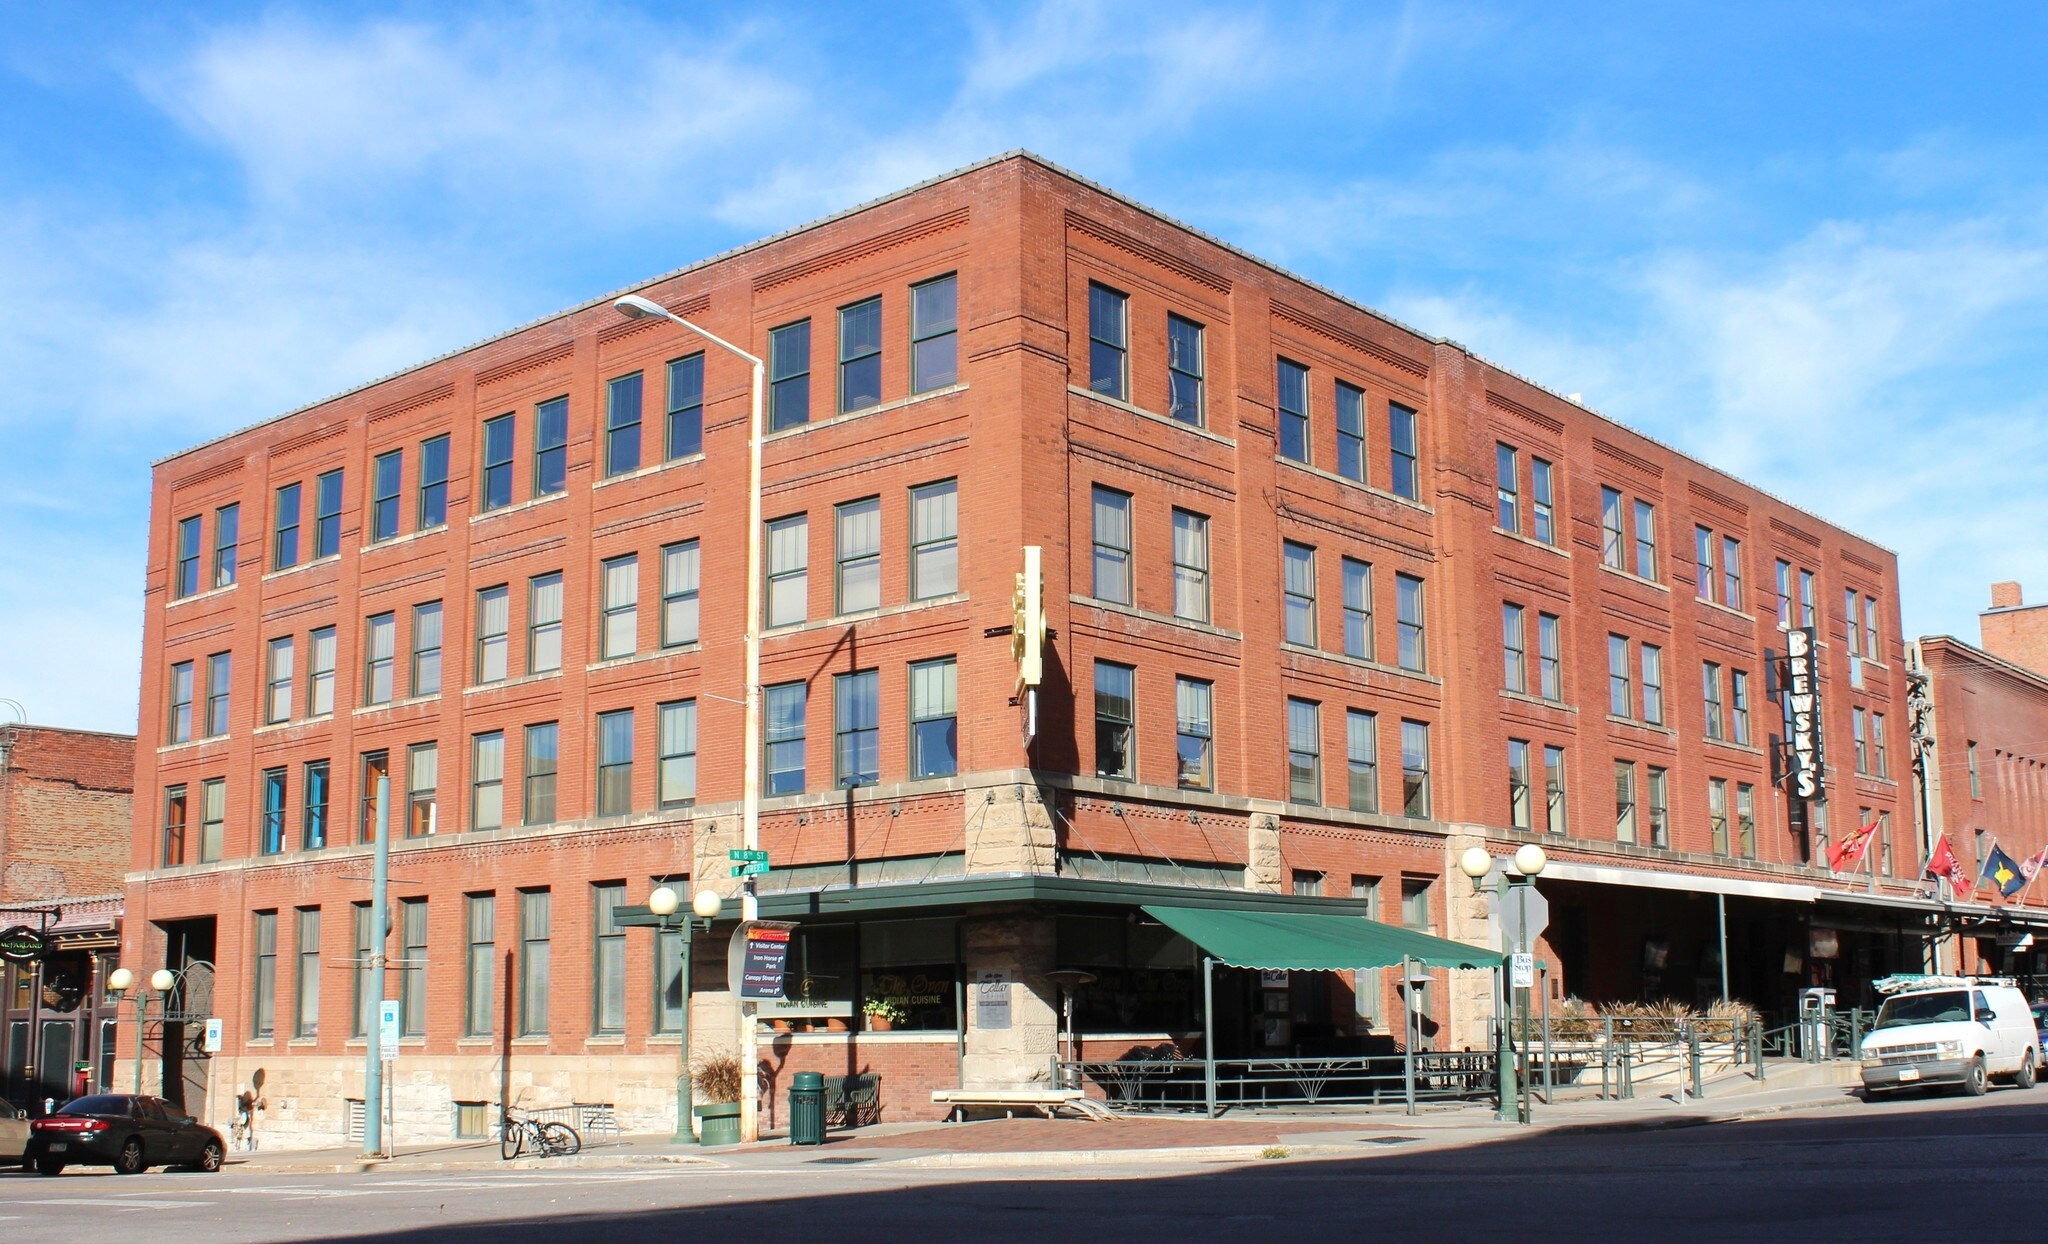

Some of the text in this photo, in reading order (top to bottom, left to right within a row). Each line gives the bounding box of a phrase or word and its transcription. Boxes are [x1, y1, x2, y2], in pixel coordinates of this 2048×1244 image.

[1788, 630, 1816, 798] BREWSKY'S
[734, 851, 740, 859] N
[756, 852, 764, 860] ST
[743, 863, 765, 874] STREET
[1516, 955, 1531, 963] Bus
[1514, 964, 1532, 973] Stop
[744, 974, 762, 982] Canopy
[776, 1000, 799, 1008] INDIAN
[911, 995, 941, 1005] CUISINE
